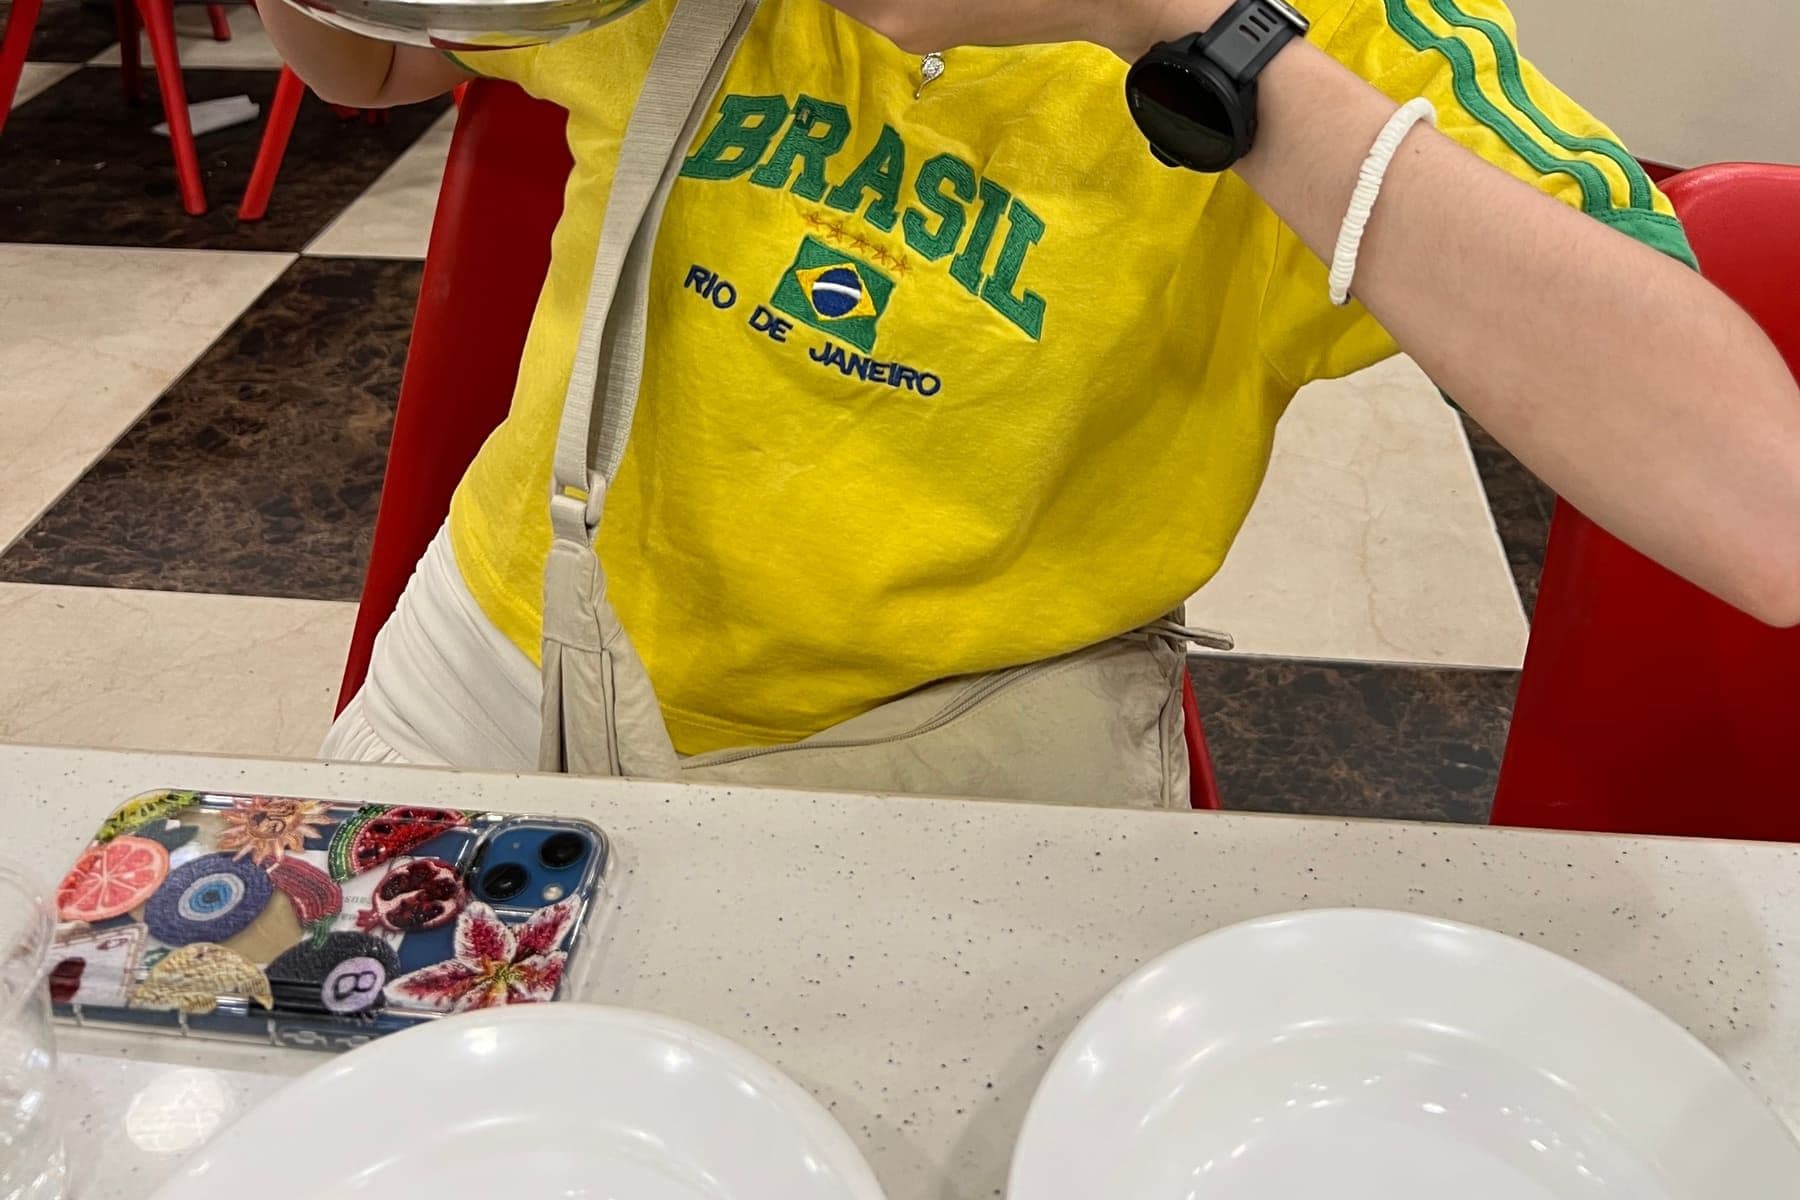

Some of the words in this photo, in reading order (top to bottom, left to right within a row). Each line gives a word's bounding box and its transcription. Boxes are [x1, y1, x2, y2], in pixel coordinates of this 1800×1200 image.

[679, 93, 1047, 342] BRASIL
[684, 264, 737, 310] RIO
[748, 305, 793, 343] DE
[808, 341, 942, 397] JANEIRO
[333, 970, 378, 1000] 8
